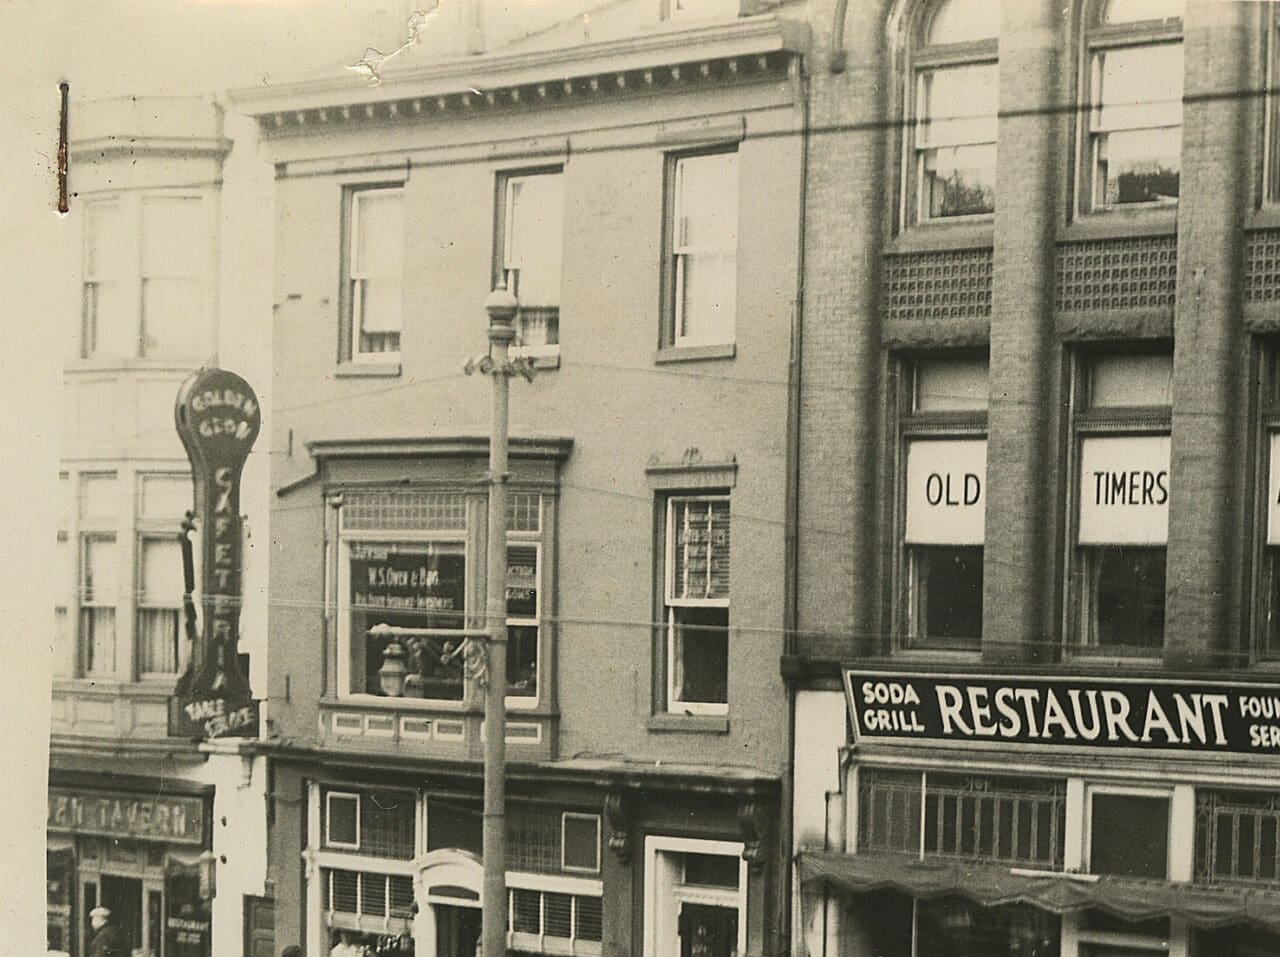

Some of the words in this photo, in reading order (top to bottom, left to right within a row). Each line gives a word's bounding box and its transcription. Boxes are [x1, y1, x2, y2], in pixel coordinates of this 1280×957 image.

[926, 473, 981, 506] OLD
[1093, 471, 1168, 505] TIMERS
[862, 681, 921, 705] SODA
[863, 709, 925, 732] GRILL
[935, 685, 1229, 745] RESTAURANT
[97, 799, 186, 836] TAVERN
